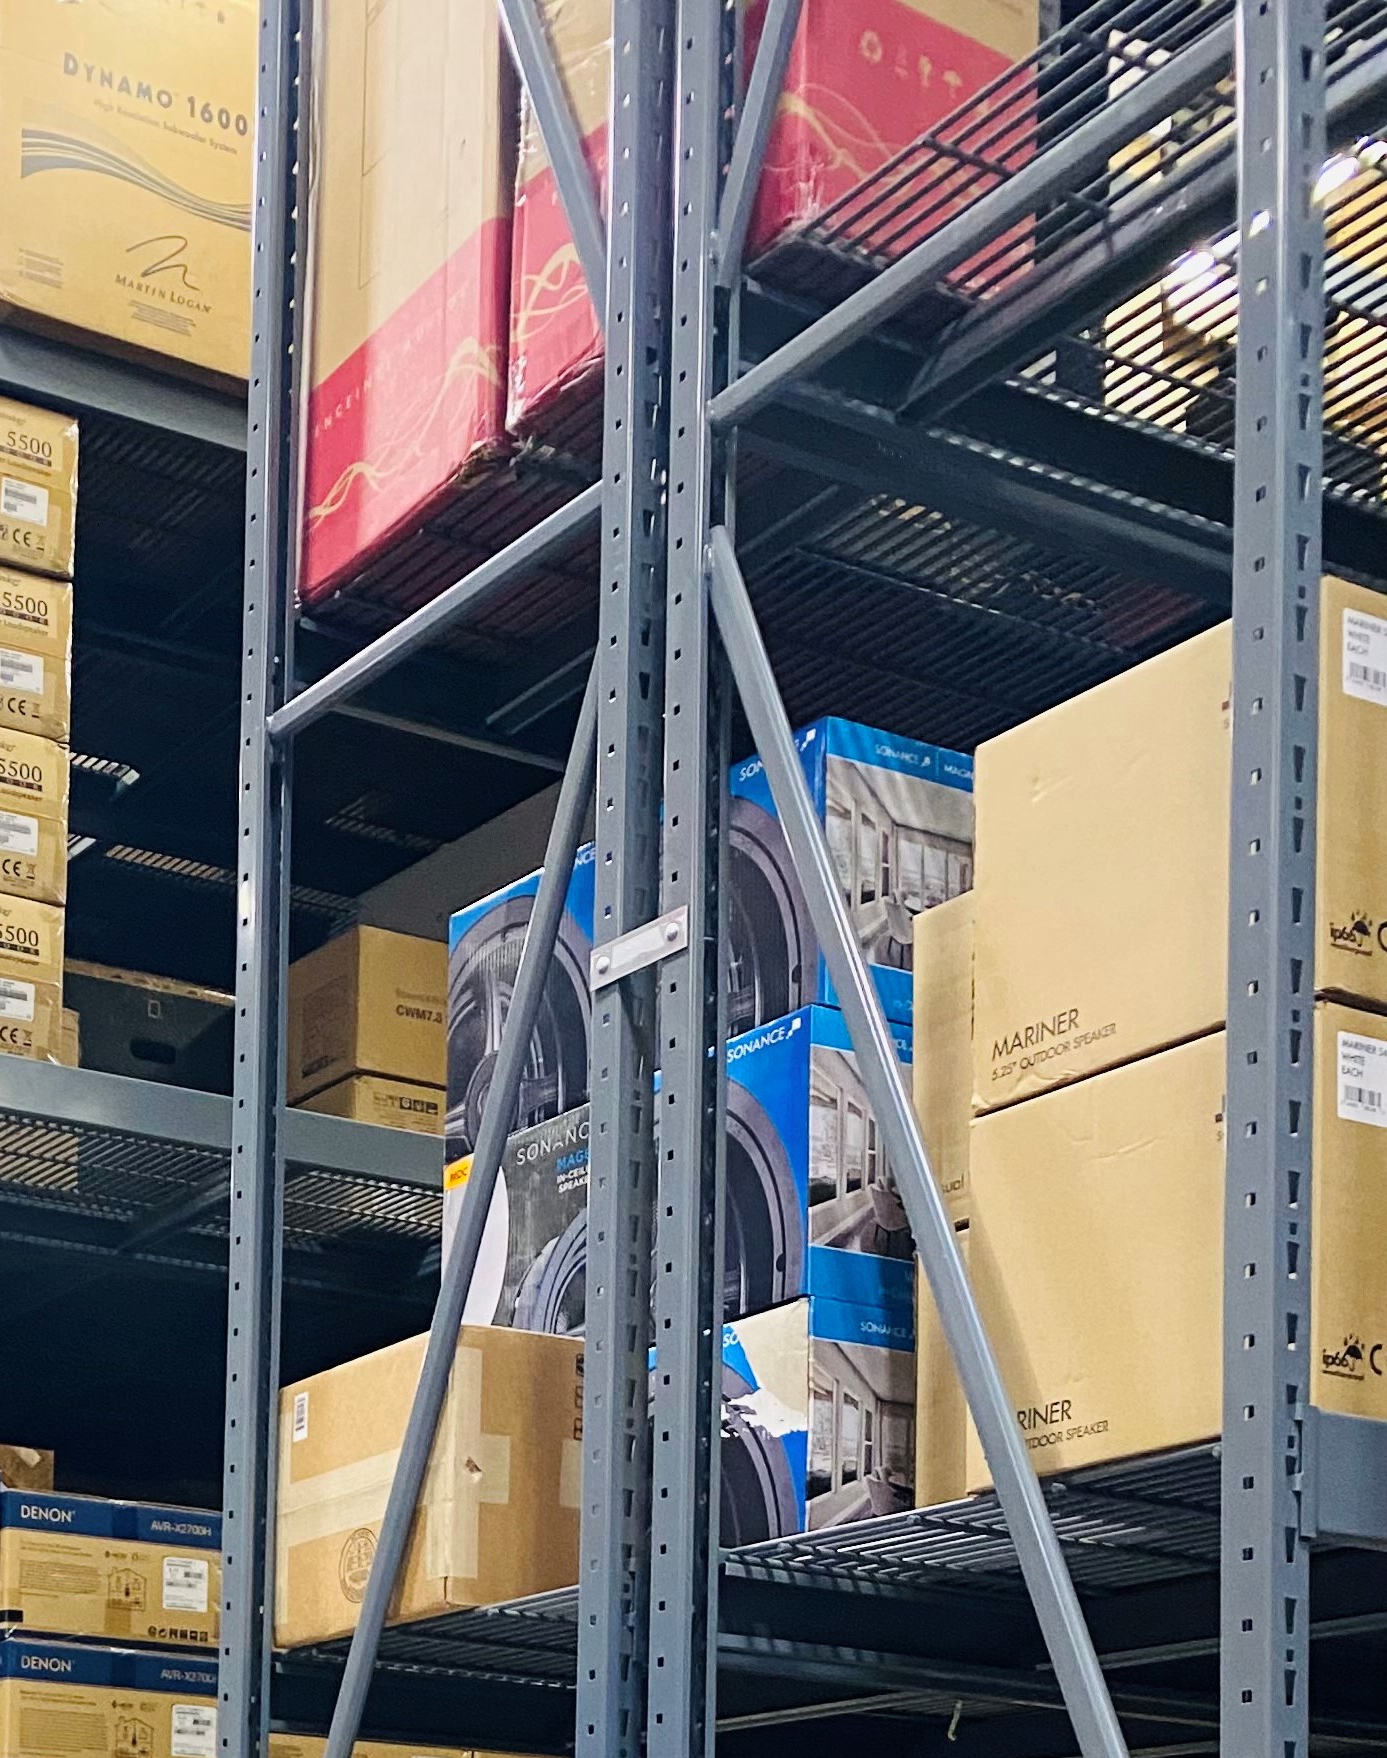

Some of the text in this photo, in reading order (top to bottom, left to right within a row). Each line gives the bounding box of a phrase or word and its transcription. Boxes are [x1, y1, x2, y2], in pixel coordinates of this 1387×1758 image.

[63, 52, 248, 136] DYNAMO 1600
[115, 274, 212, 314] MARTIN LOGAN
[6, 431, 52, 458] 5500
[2, 592, 48, 617] 5500
[738, 758, 765, 782] SON
[727, 1026, 785, 1063] SONANCE
[991, 1008, 1081, 1062] MARINER
[1019, 1040, 1071, 1071] OUTDOOR
[1073, 1022, 1117, 1050] SPEAKER
[1341, 1039, 1377, 1055] MARINER
[1341, 1066, 1364, 1079] EACH
[516, 1121, 590, 1166] SONANC
[556, 1147, 590, 1171] MAG
[558, 1176, 589, 1194] SPEAK
[723, 1331, 739, 1348] SO
[1016, 1399, 1072, 1431] RINER
[1025, 1420, 1109, 1450] TDOOR SPEAKER
[20, 1504, 212, 1537] DENON AVR-X2700H
[20, 1655, 217, 1685] DENON AVR-X2700
